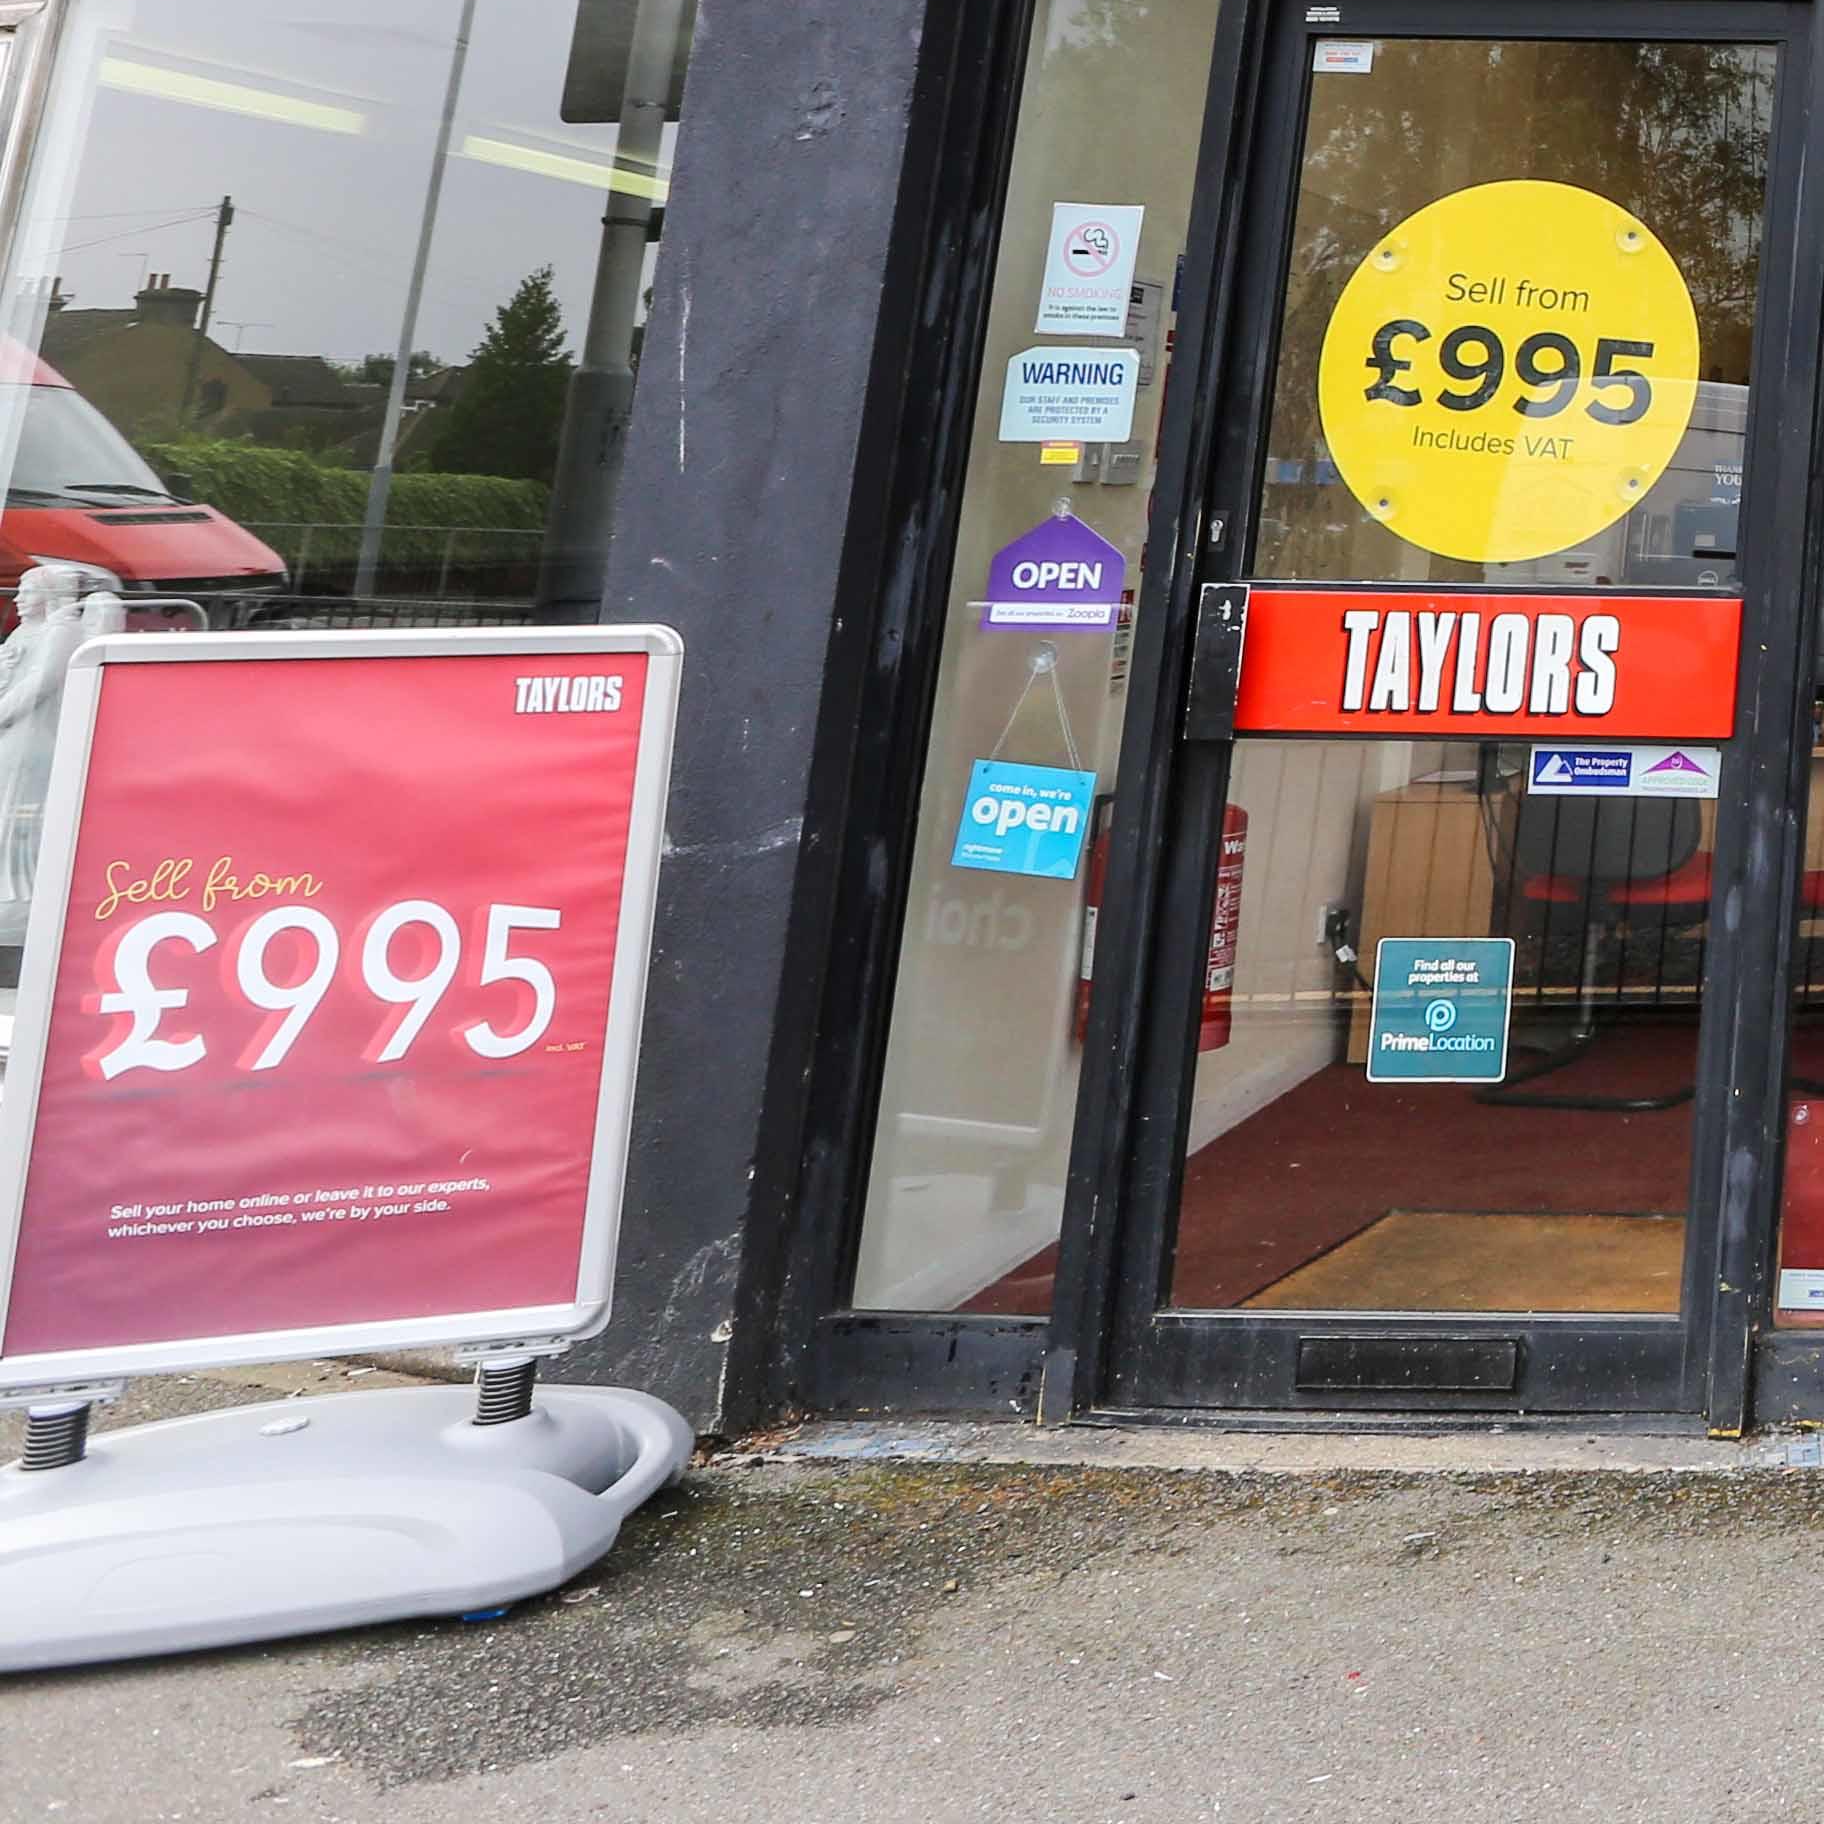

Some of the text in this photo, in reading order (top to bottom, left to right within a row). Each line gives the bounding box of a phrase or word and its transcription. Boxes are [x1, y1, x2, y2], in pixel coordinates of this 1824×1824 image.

[1445, 273, 1590, 313] Sell from
[1022, 362, 1124, 386] WARNING
[1363, 319, 1656, 426] £995
[1062, 396, 1078, 404] AND
[1412, 426, 1574, 460] Includes VAT
[1011, 562, 1103, 590] OPEN
[1339, 609, 1622, 718] TAYLORS
[514, 674, 625, 714] TAYLORS
[1573, 767, 1627, 777] Ombudsman
[1575, 757, 1629, 768] The Property
[989, 783, 1072, 801] come in, we're
[972, 796, 1079, 837] open
[93, 856, 323, 921] Sell from
[1408, 971, 1479, 985] properties at
[1413, 959, 1476, 972] Find all our
[97, 899, 562, 1082] £995
[1380, 1032, 1495, 1051] PrimeLocation
[110, 1177, 491, 1221] Sell your home online or leave it to our experts,
[107, 1197, 452, 1239] whichever you choose, we're by your side.
